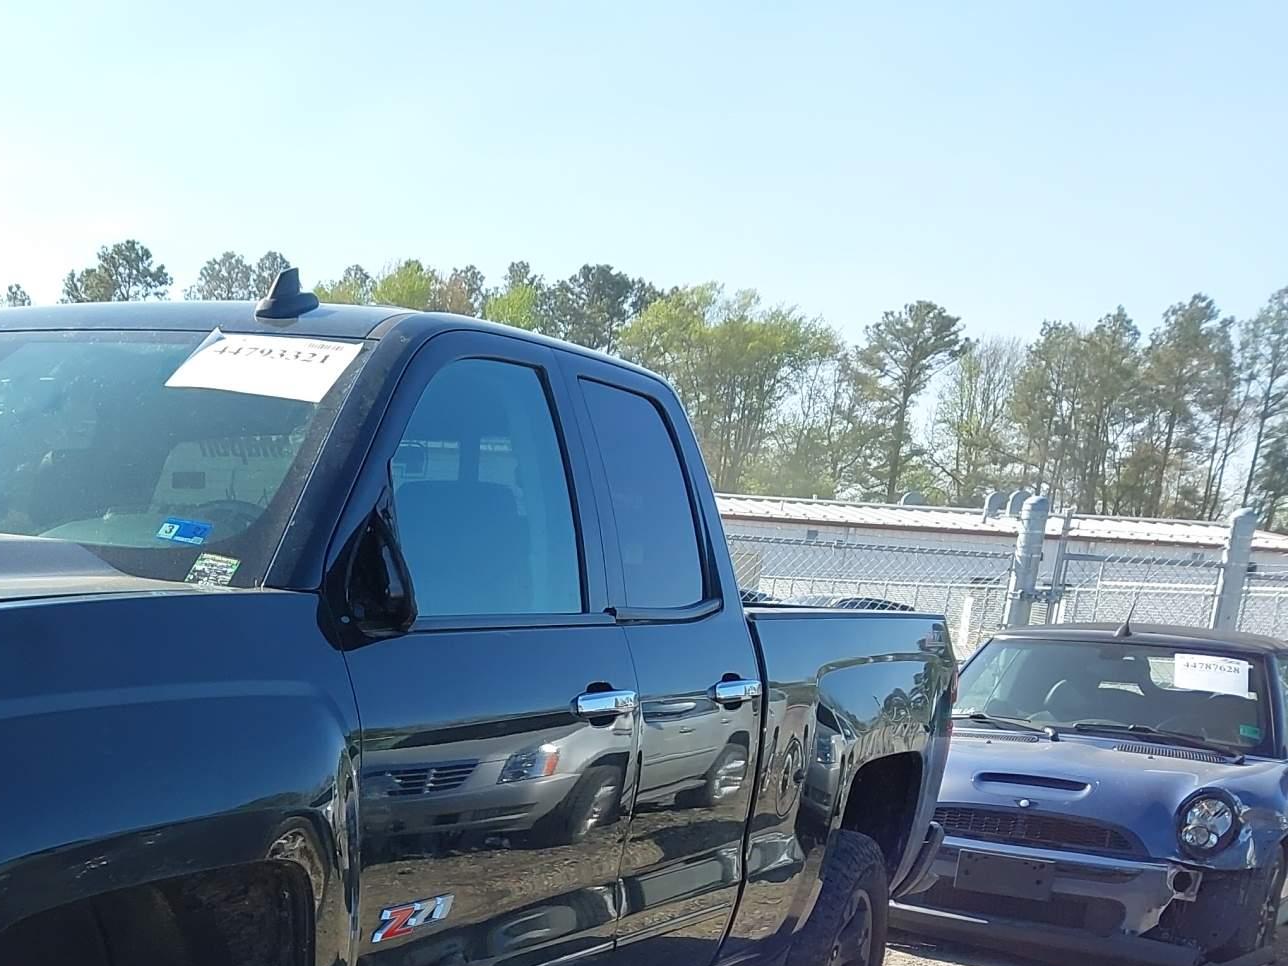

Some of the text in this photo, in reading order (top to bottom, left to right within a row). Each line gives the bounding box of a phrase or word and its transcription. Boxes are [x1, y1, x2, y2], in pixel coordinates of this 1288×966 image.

[214, 346, 331, 365] 44793321
[164, 524, 175, 535] 3
[1183, 661, 1241, 674] 44787628
[371, 893, 456, 943] Z71
